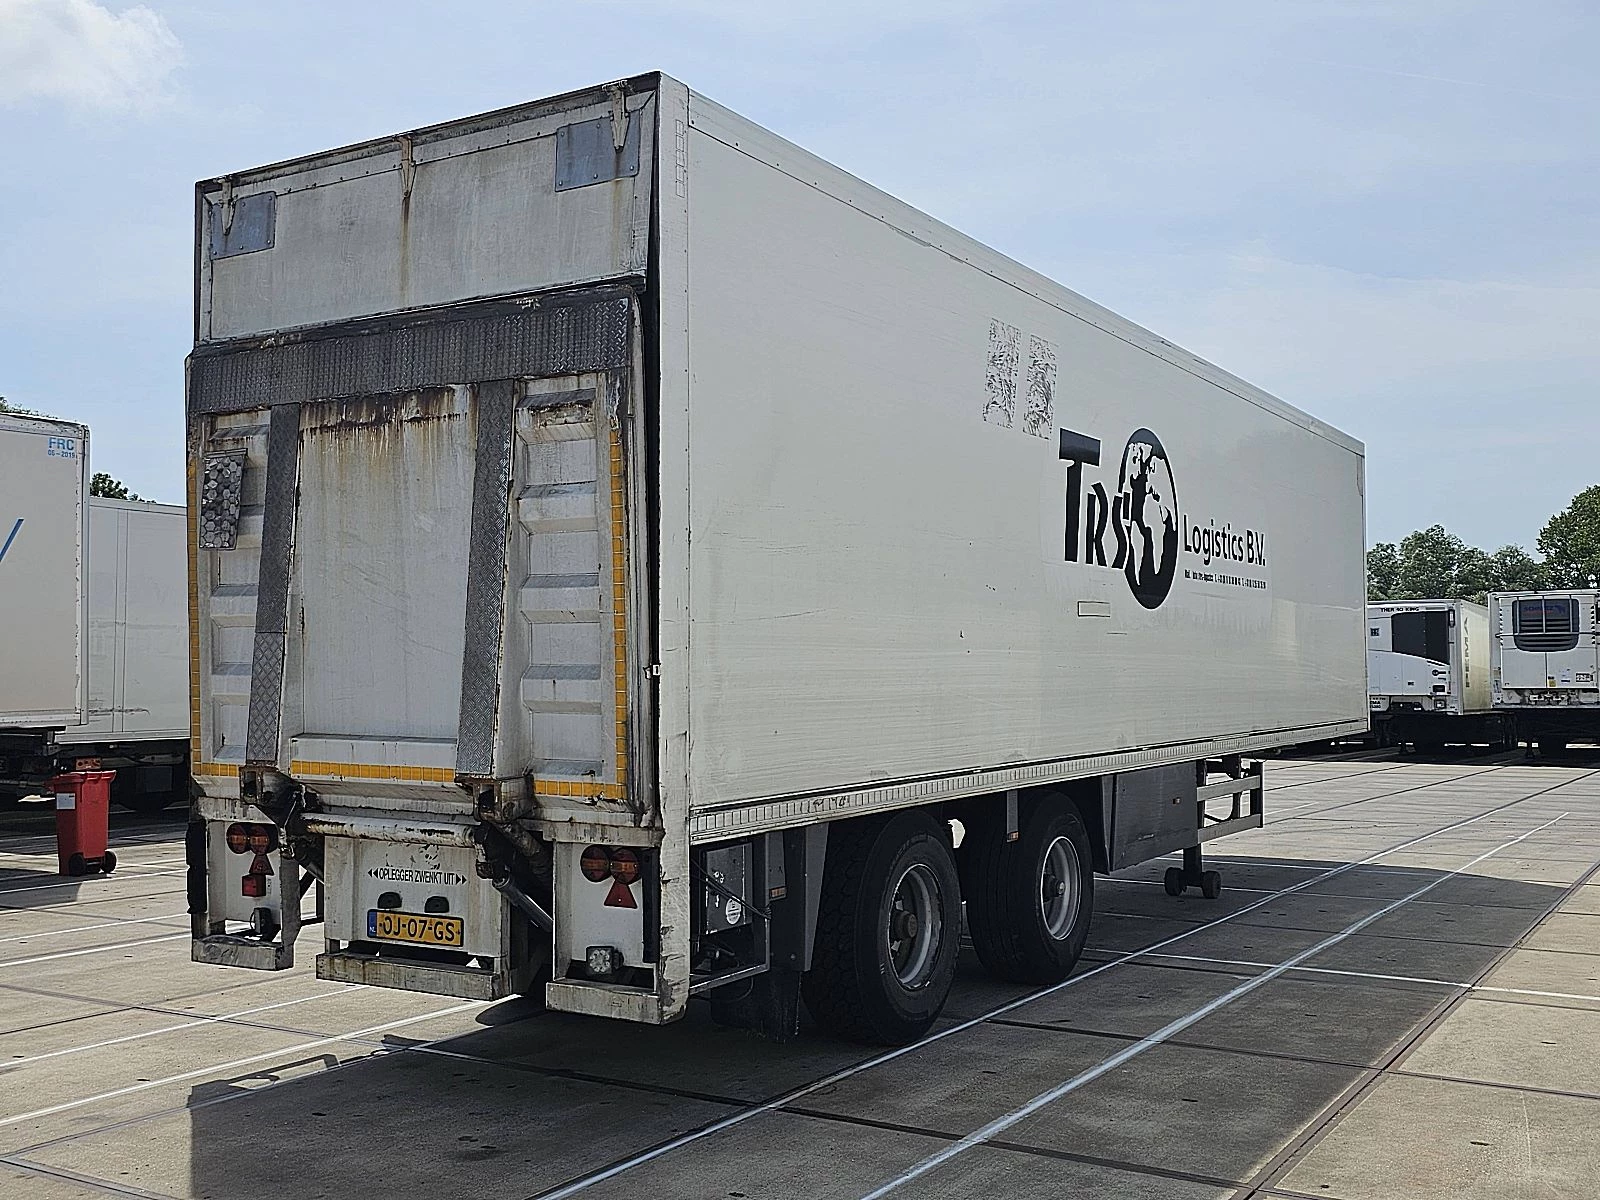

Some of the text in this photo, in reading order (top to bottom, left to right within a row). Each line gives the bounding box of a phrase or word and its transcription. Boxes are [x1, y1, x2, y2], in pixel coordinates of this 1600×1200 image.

[48, 437, 75, 451] FRC
[1183, 514, 1266, 567] Logistics B.V.
[379, 867, 455, 885] OPLEGGER ZWENKT UIT
